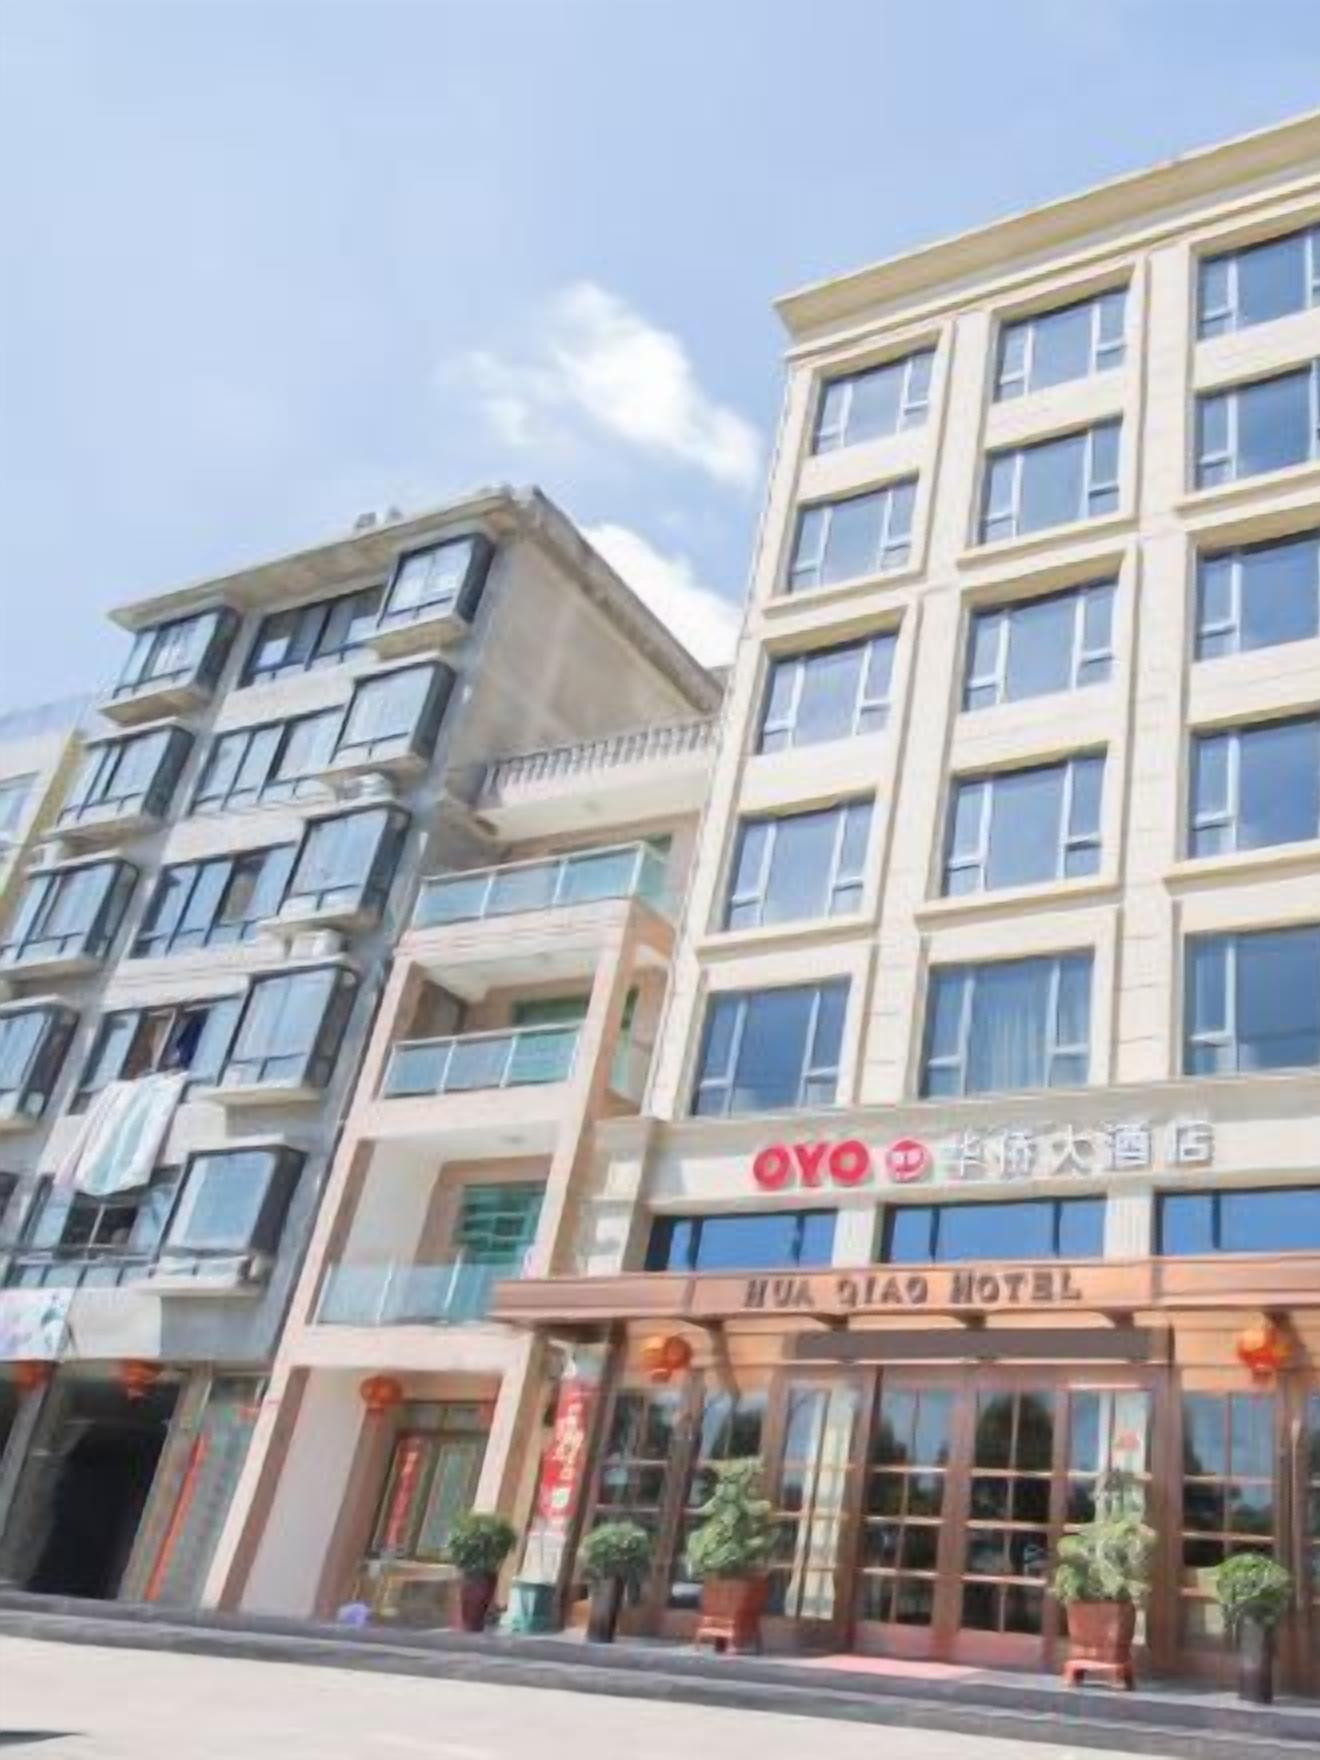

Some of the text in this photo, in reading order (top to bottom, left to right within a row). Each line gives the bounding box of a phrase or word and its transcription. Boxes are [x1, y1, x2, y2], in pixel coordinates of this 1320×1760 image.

[753, 1139, 869, 1191] OYO
[743, 1269, 1082, 1308] HUA QIAO HOTEL
